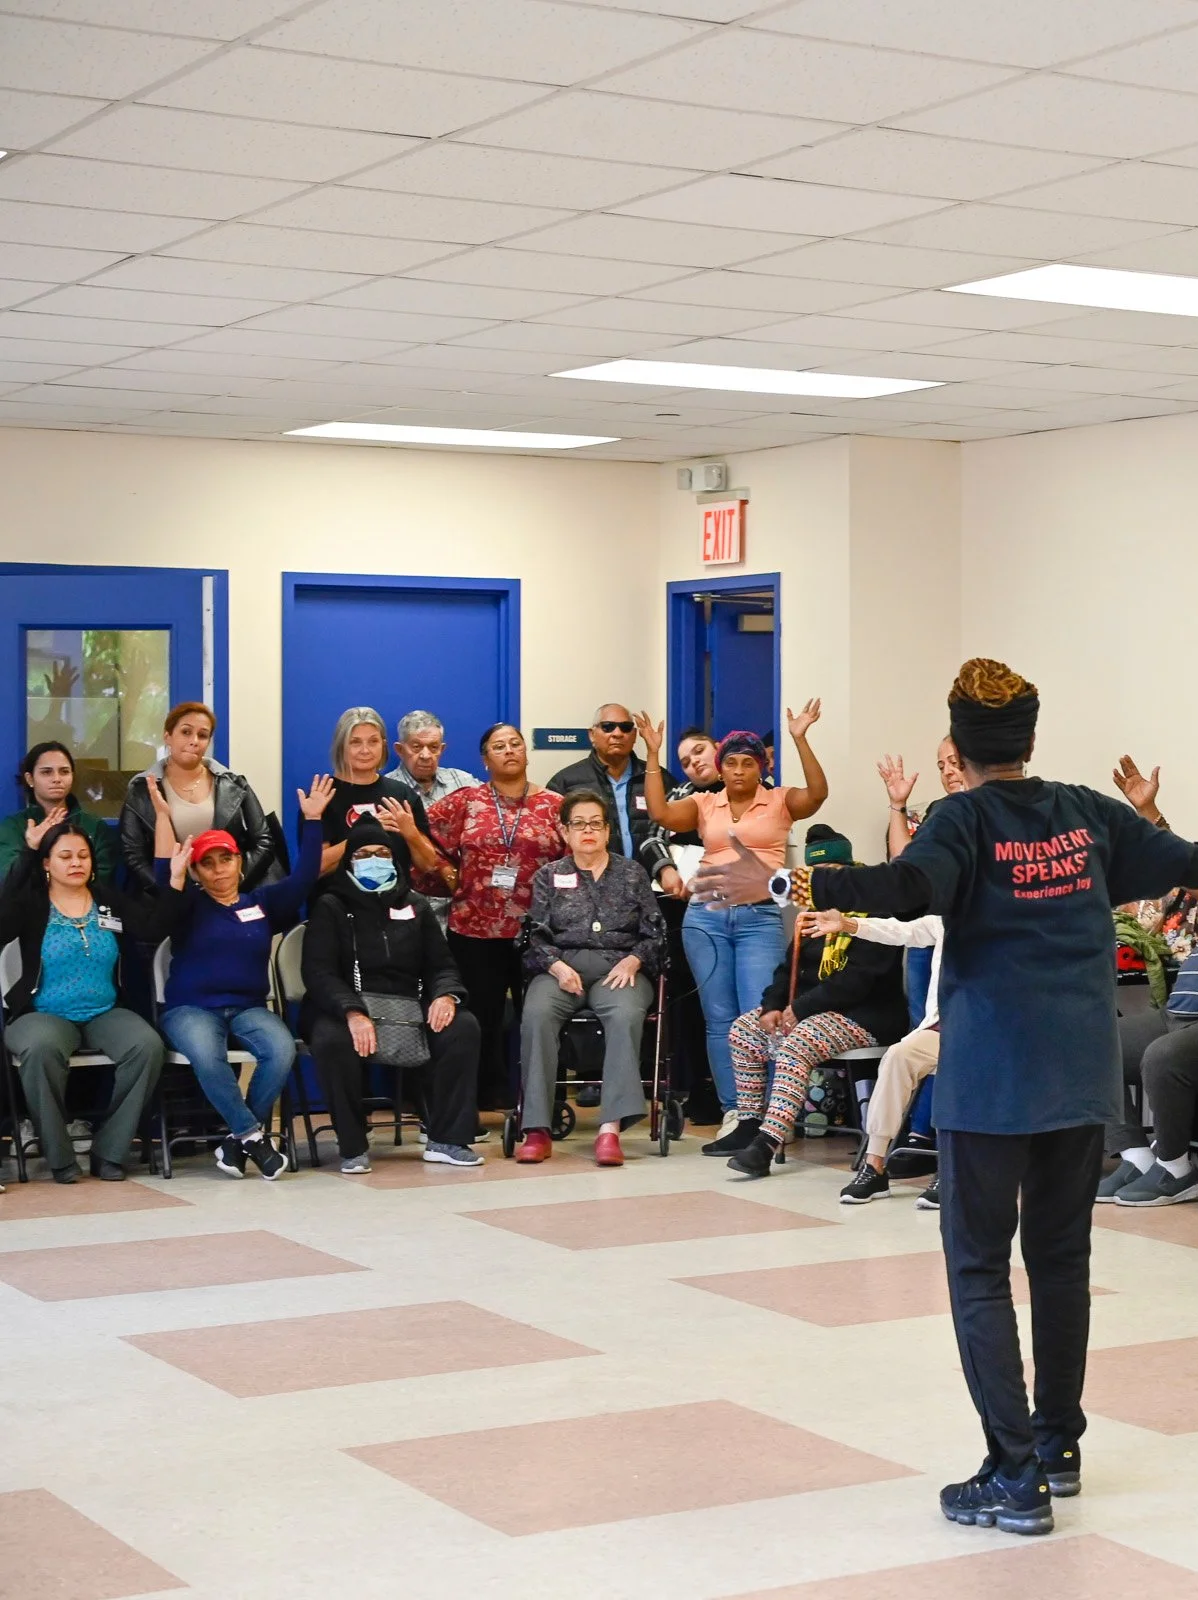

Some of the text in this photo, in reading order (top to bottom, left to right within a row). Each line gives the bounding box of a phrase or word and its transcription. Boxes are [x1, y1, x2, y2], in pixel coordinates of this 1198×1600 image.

[703, 509, 735, 561] EXIT
[548, 735, 577, 743] STORAGE
[995, 828, 1094, 861] MOVEMENT
[1014, 876, 1092, 899] Experience Joy
